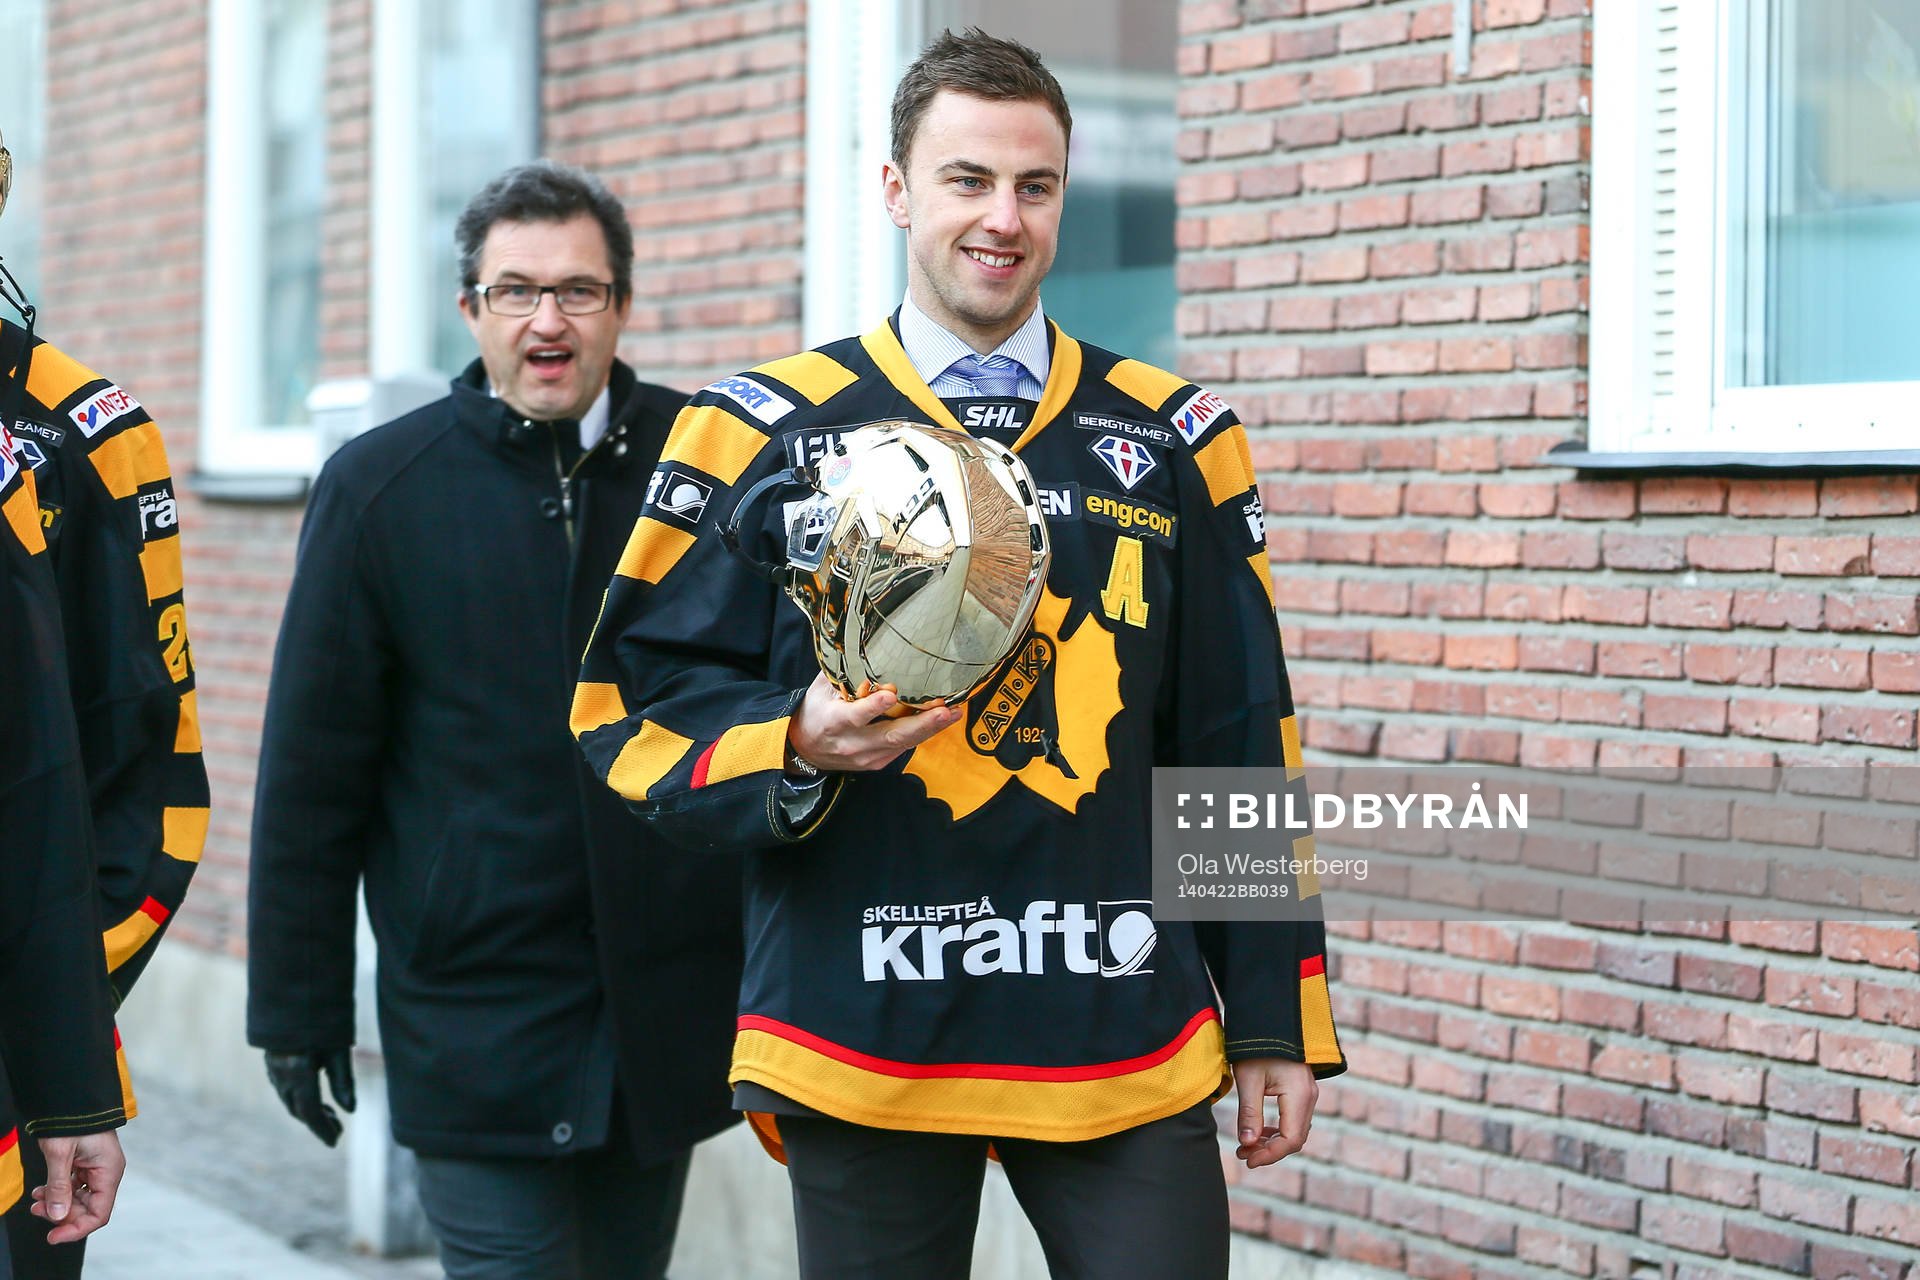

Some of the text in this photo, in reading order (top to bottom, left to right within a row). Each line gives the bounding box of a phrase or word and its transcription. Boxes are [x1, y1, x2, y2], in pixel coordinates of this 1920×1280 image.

[962, 405, 1023, 428] SHL
[1078, 416, 1173, 442] BERGTEAMET
[1100, 535, 1149, 629] A
[158, 602, 196, 684] 2
[1015, 727, 1046, 743] 192
[862, 895, 997, 925] SKELLEFTEÅ
[861, 900, 1099, 982] kraft
